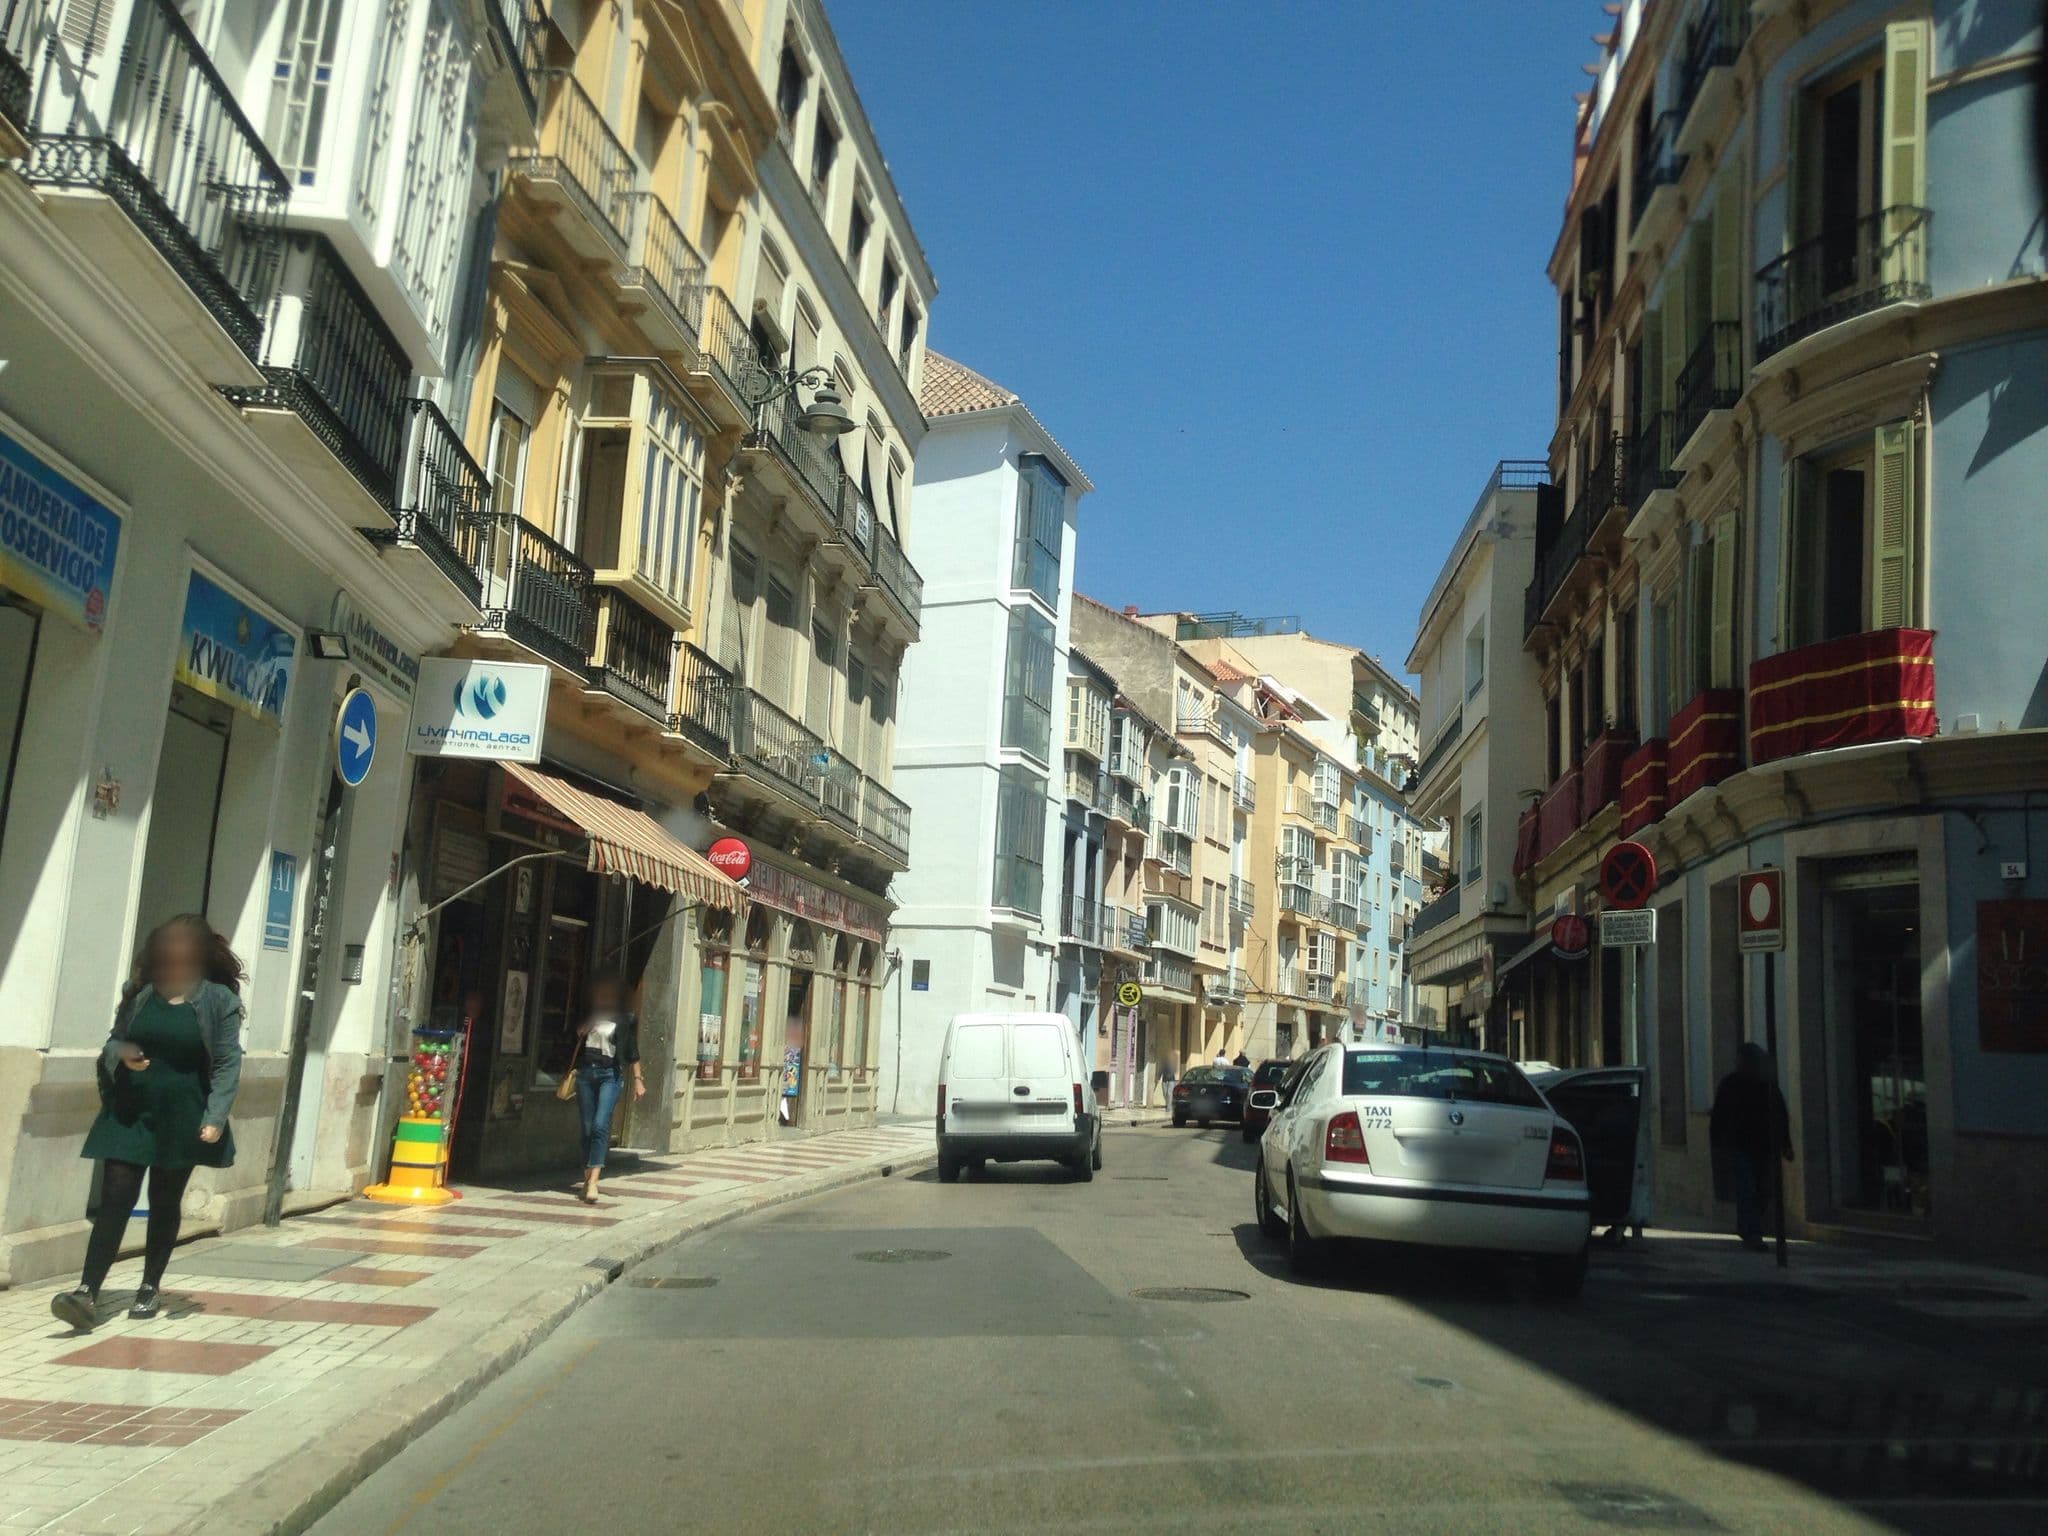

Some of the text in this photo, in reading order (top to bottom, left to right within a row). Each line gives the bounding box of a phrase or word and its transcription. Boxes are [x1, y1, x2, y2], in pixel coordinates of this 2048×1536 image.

[0, 457, 107, 564] ANDERIA DE
[0, 503, 98, 594] OSERVICIO
[1364, 1106, 1392, 1117] TAXI
[1366, 1119, 1392, 1129] 772
